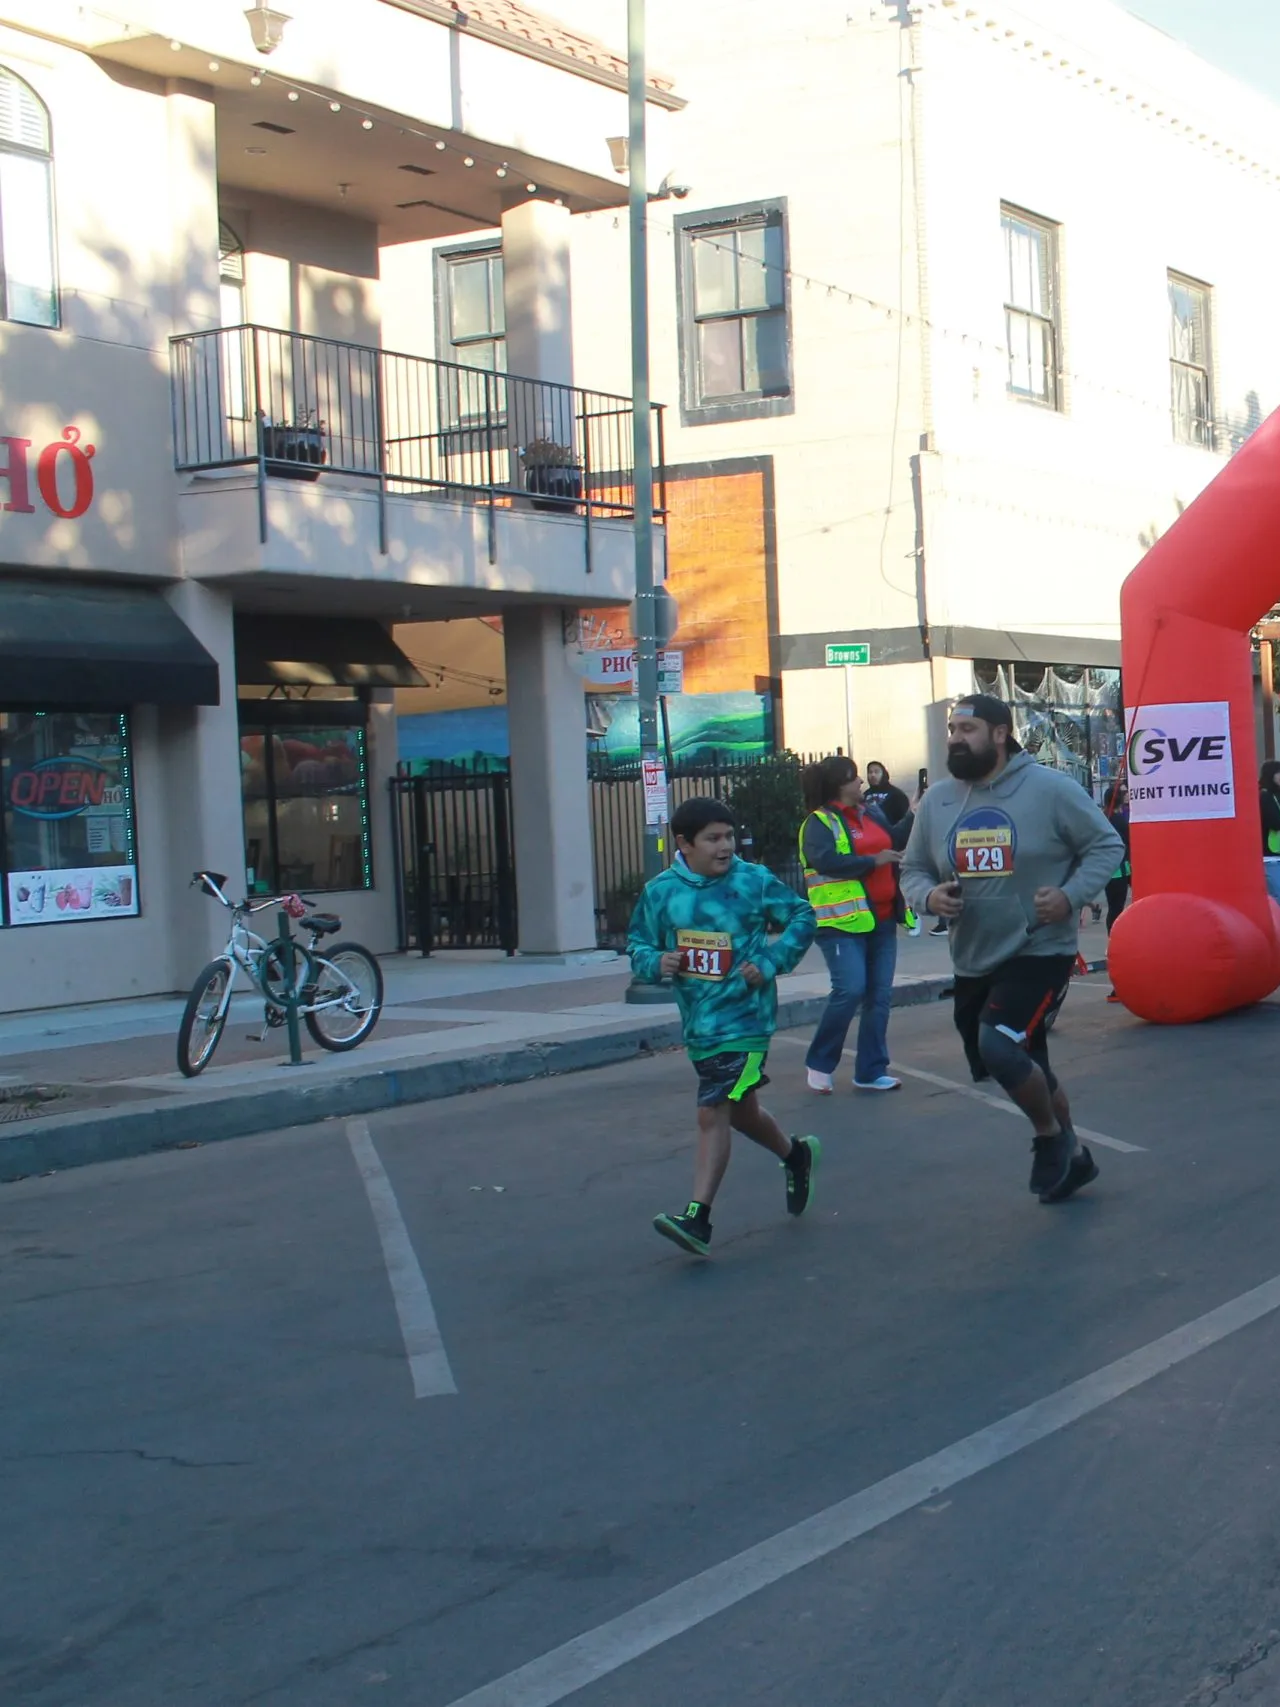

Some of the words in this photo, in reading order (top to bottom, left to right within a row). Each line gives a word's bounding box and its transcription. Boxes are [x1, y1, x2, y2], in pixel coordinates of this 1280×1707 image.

[828, 648, 861, 662] Browns
[1142, 735, 1227, 764] SVE
[10, 770, 107, 806] OPEN
[1130, 786, 1164, 800] EVENT
[1168, 782, 1231, 798] TIMING
[966, 847, 1004, 871] 129
[687, 949, 721, 974] 131
